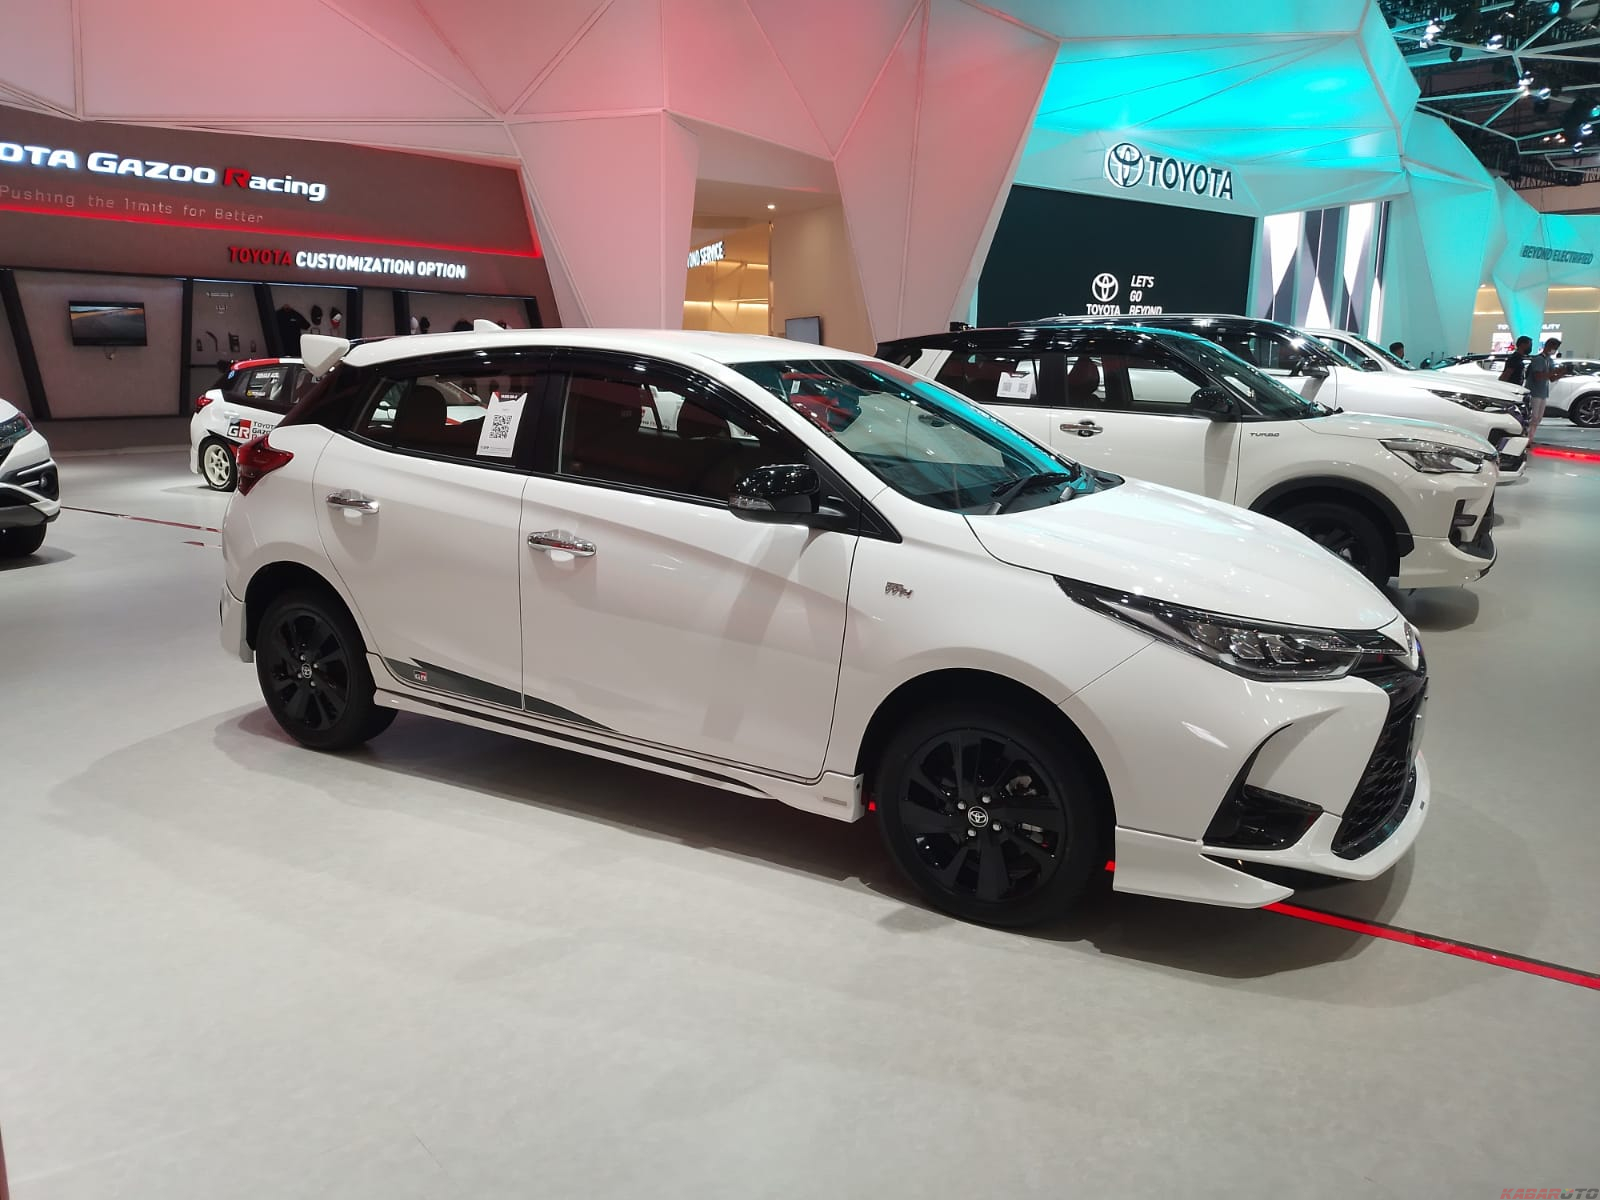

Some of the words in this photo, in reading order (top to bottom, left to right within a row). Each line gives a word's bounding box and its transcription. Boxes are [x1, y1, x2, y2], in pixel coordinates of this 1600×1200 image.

[87, 151, 216, 184] GAZOO
[223, 167, 326, 202] Racing
[1148, 155, 1234, 201] TOYOTA
[0, 185, 75, 208] Pushing
[88, 194, 115, 209] the
[125, 198, 173, 214] limits
[183, 205, 207, 217] for
[215, 208, 264, 223] Better
[700, 241, 724, 265] SERVICE
[1522, 246, 1552, 260] BEYOND
[229, 246, 291, 266] TOYOTA
[295, 251, 414, 275] CUSTOMIZATION
[417, 261, 466, 279] OPTION
[1129, 290, 1143, 302] GO
[1086, 303, 1121, 316] TOYOTA
[1129, 305, 1163, 316] BEYOND
[228, 424, 251, 439] GR
[253, 421, 275, 430] TOYOT
